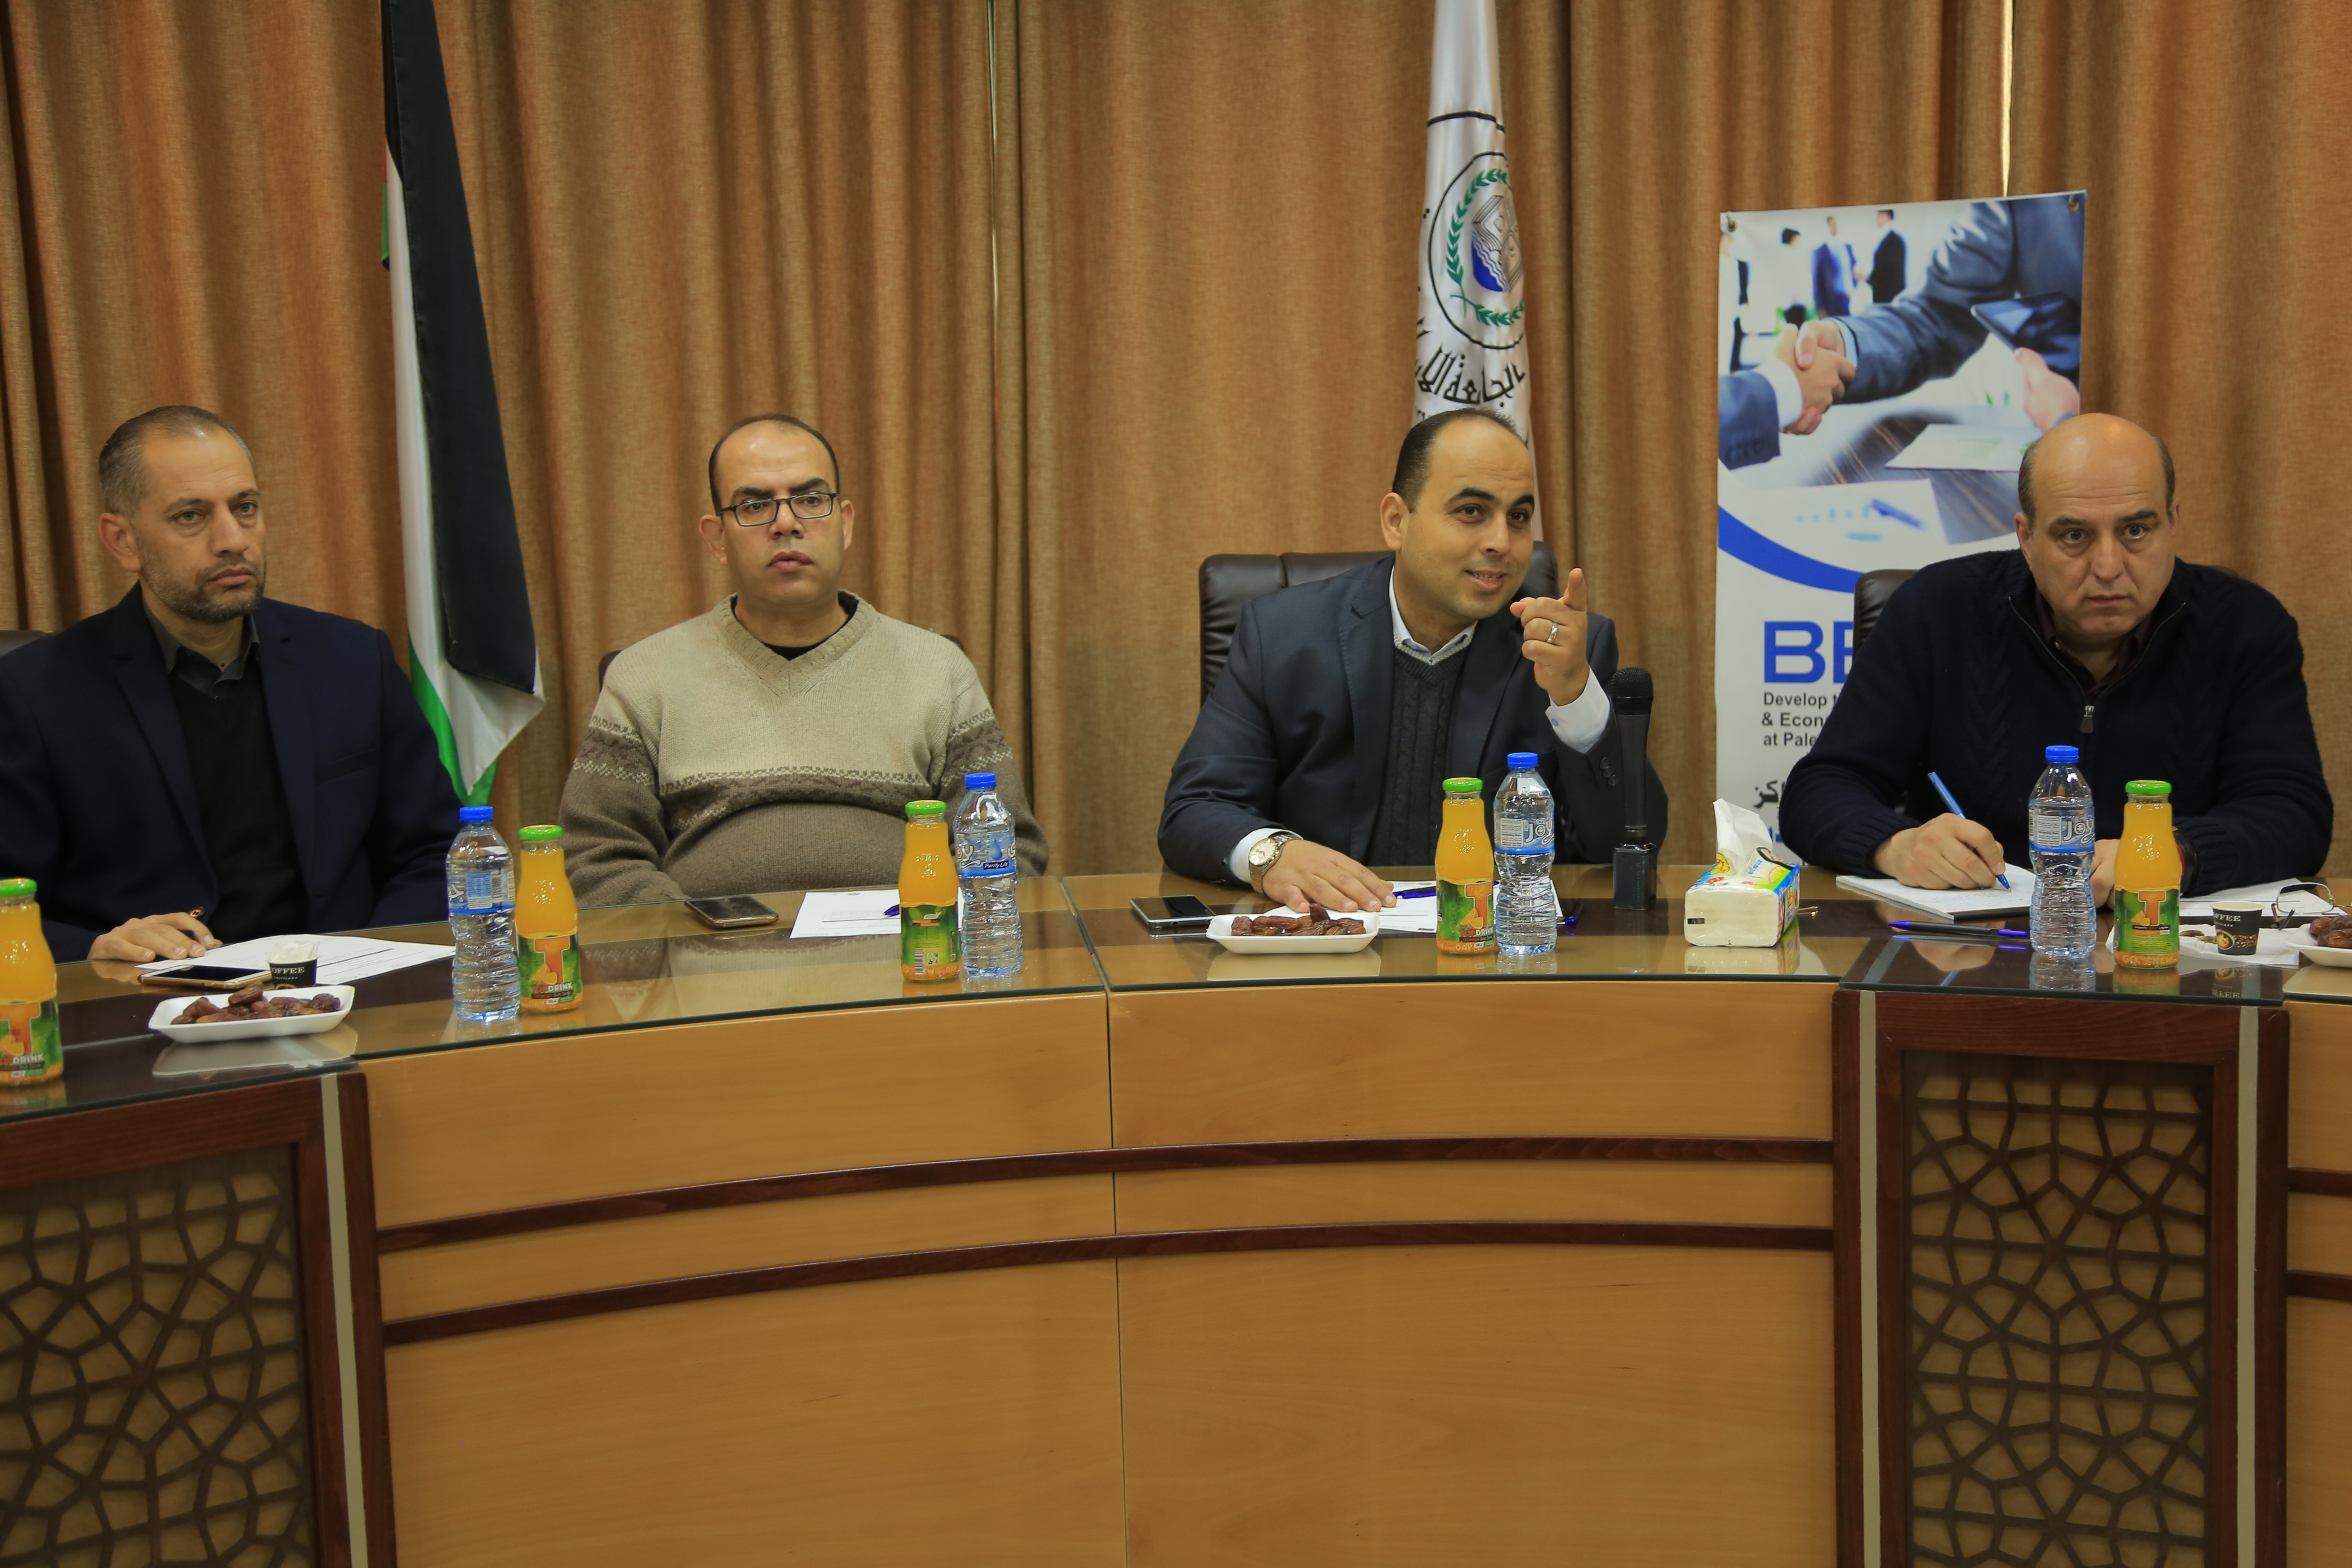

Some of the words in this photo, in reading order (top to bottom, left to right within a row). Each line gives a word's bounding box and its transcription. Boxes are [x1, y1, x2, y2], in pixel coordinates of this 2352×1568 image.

[1764, 692, 1827, 709] Develop
[1762, 712, 1773, 726] &
[1780, 713, 1827, 726] Econ
[1764, 733, 1777, 746] at
